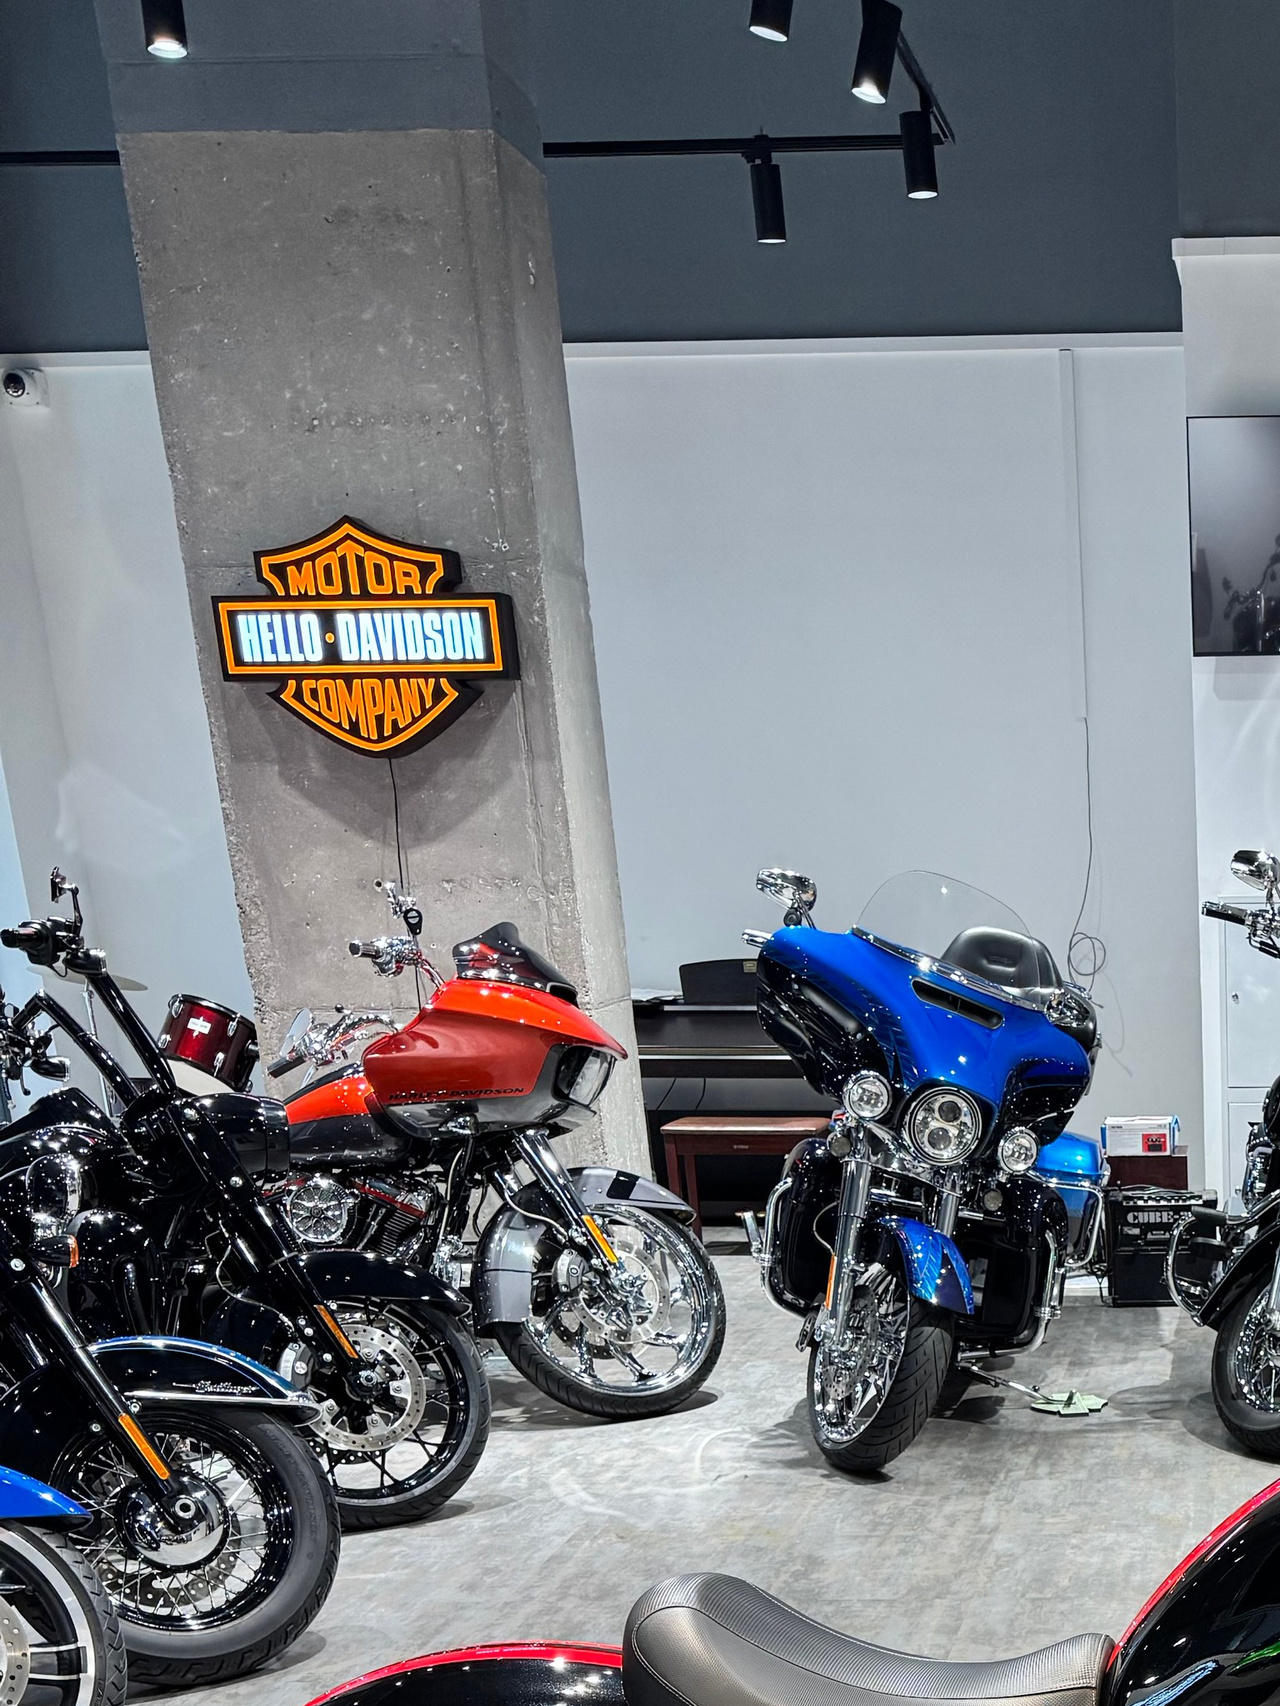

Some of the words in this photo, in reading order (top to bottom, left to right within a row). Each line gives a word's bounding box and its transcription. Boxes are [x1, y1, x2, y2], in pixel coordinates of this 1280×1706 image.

[287, 540, 421, 595] MOTOR
[237, 613, 323, 663] HELLO
[336, 611, 485, 662] DAVIDSON
[302, 678, 436, 739] COMPANY
